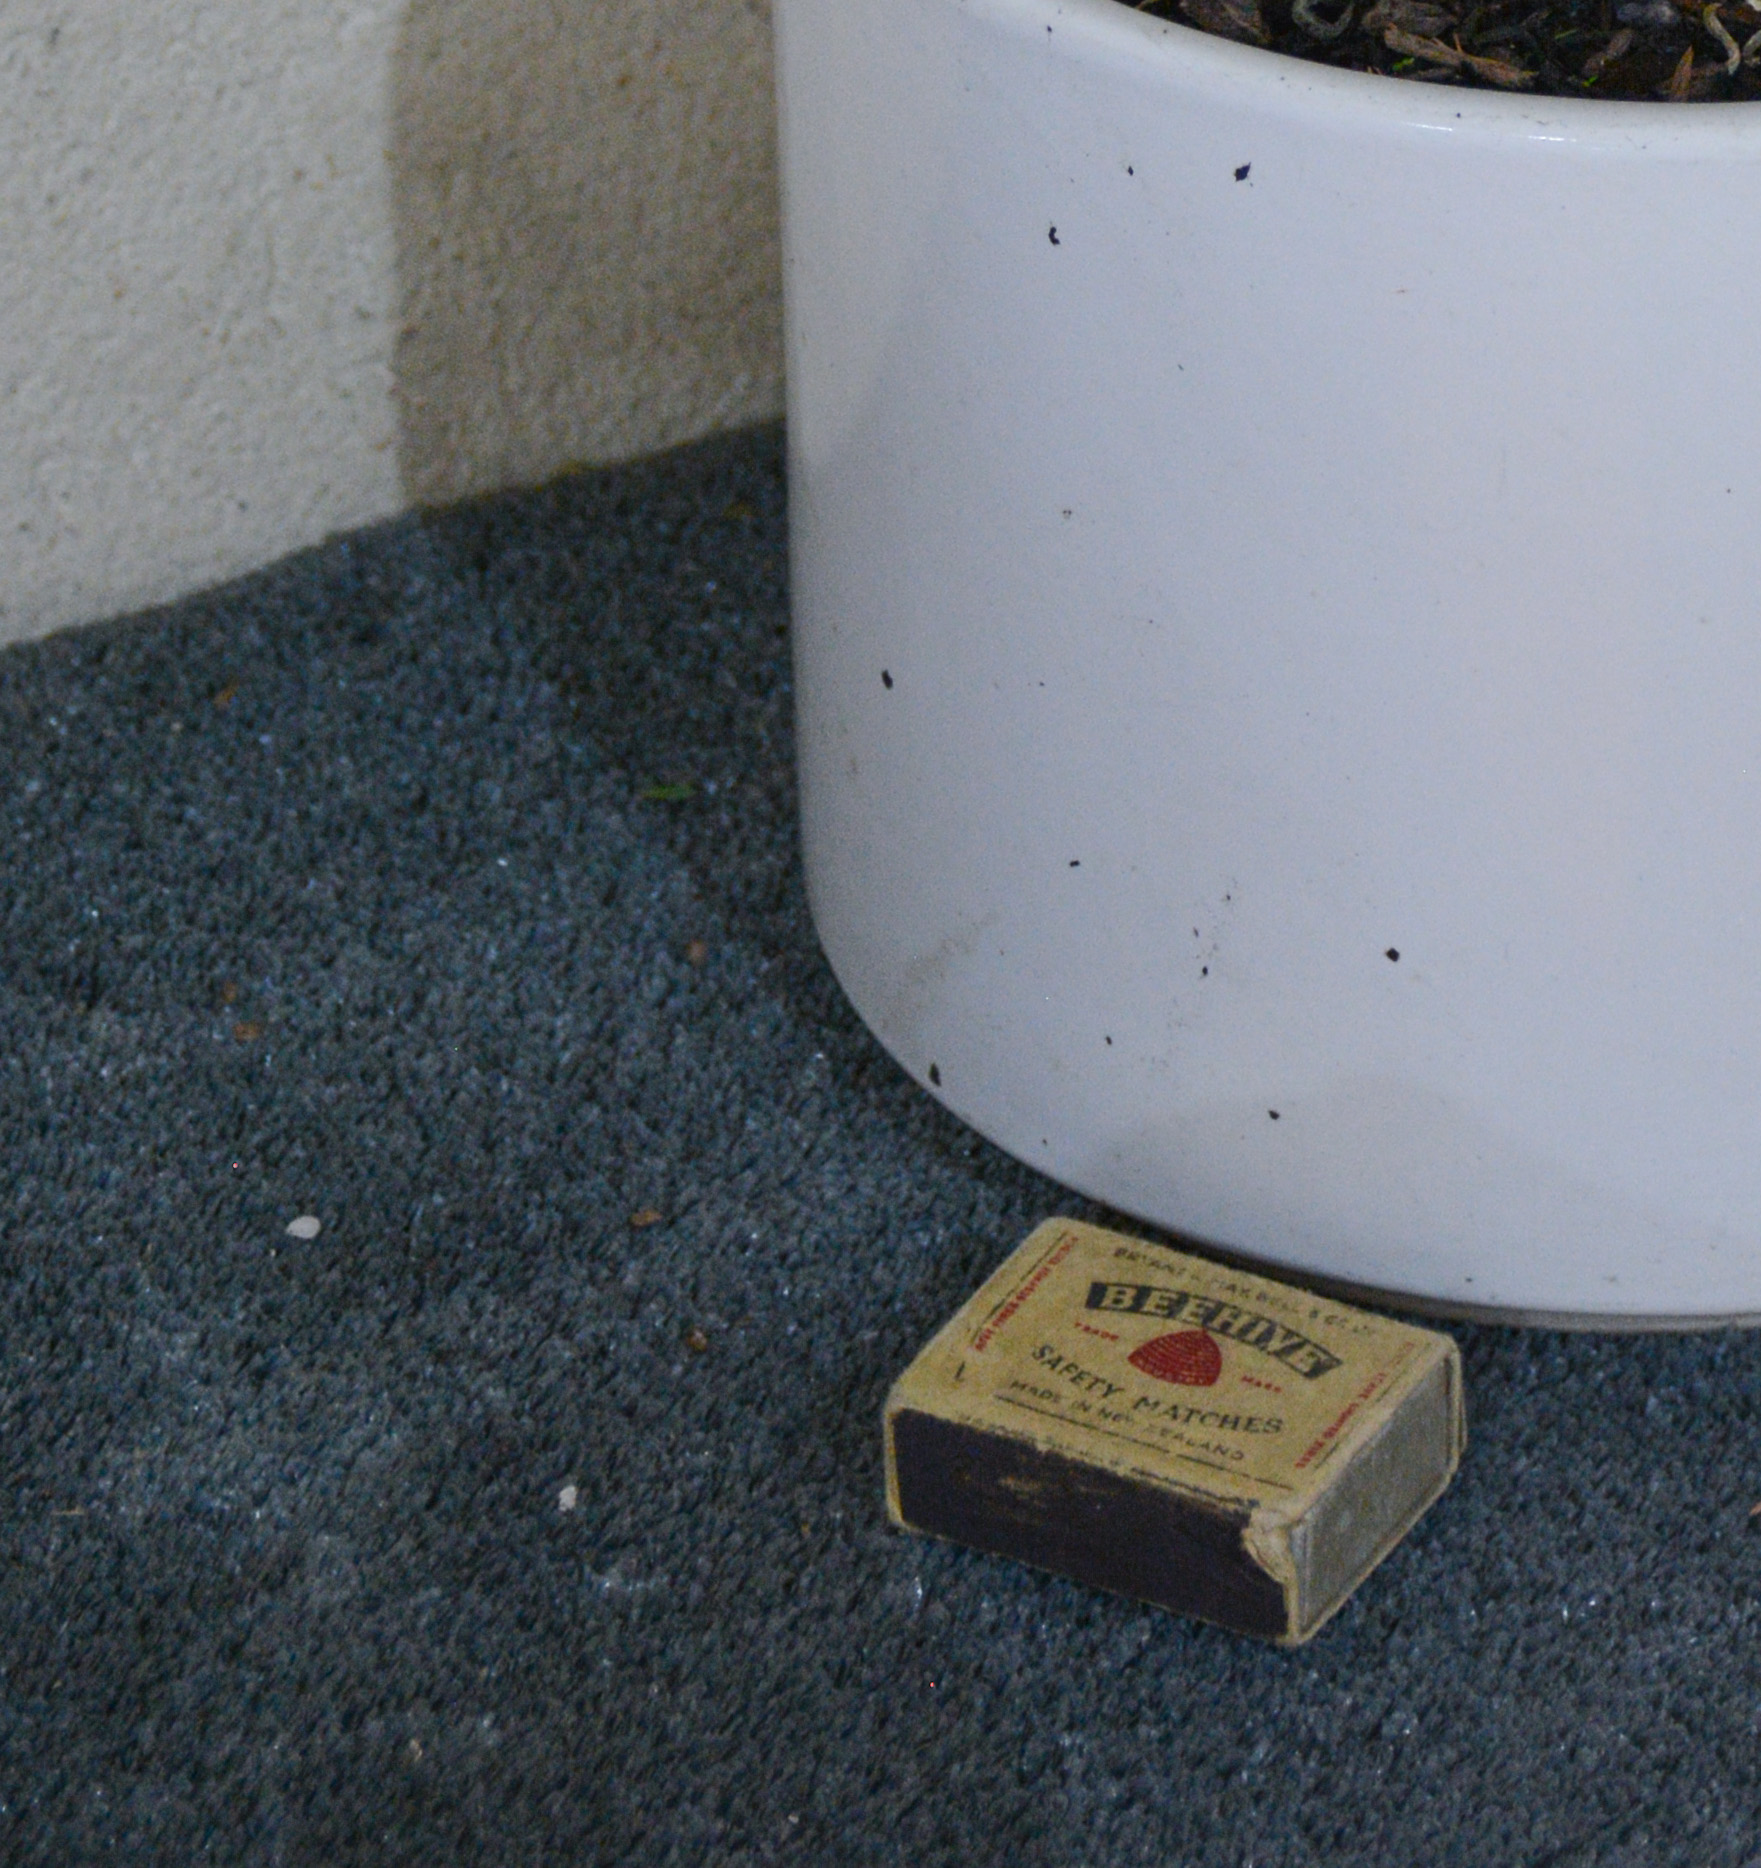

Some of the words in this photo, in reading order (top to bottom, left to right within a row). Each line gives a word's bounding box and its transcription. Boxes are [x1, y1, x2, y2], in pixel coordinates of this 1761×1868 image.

[1098, 1283, 1333, 1375] BEEHIVE
[1010, 1379, 1062, 1406] MADE
[1031, 1343, 1124, 1399] SAFETY
[1133, 1395, 1284, 1436] MATCHES
